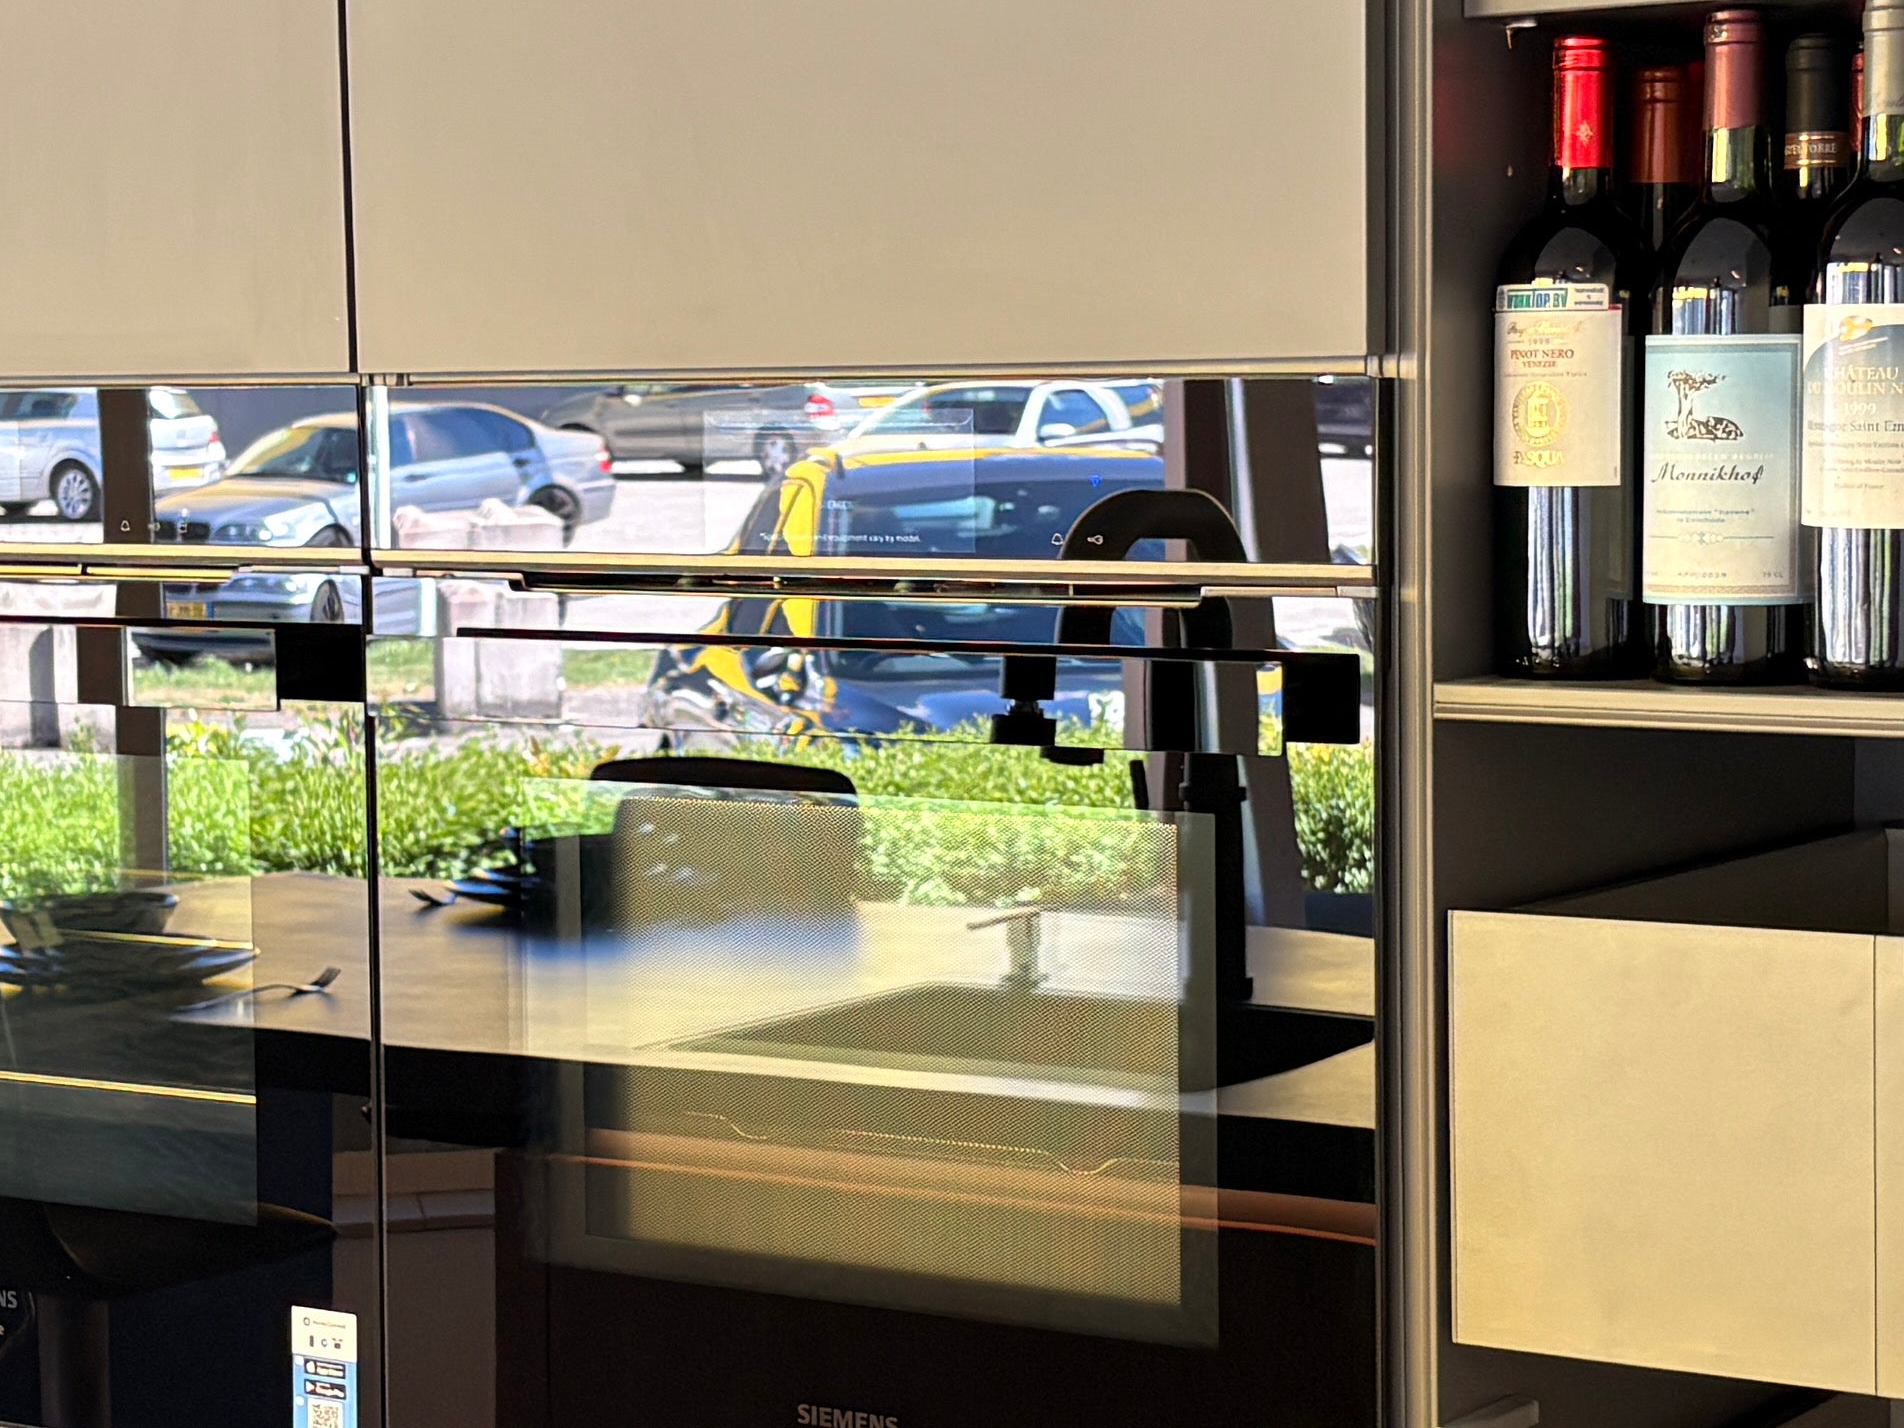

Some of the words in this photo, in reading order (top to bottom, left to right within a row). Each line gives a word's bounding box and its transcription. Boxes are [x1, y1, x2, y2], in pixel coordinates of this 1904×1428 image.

[1510, 349, 1538, 361] PINOT
[1542, 348, 1574, 360] NERO
[1827, 364, 1899, 381] HÂTEAU
[1828, 382, 1886, 395] OULIN
[1850, 420, 1880, 433] Saint
[1651, 462, 1764, 485] Monnikhof
